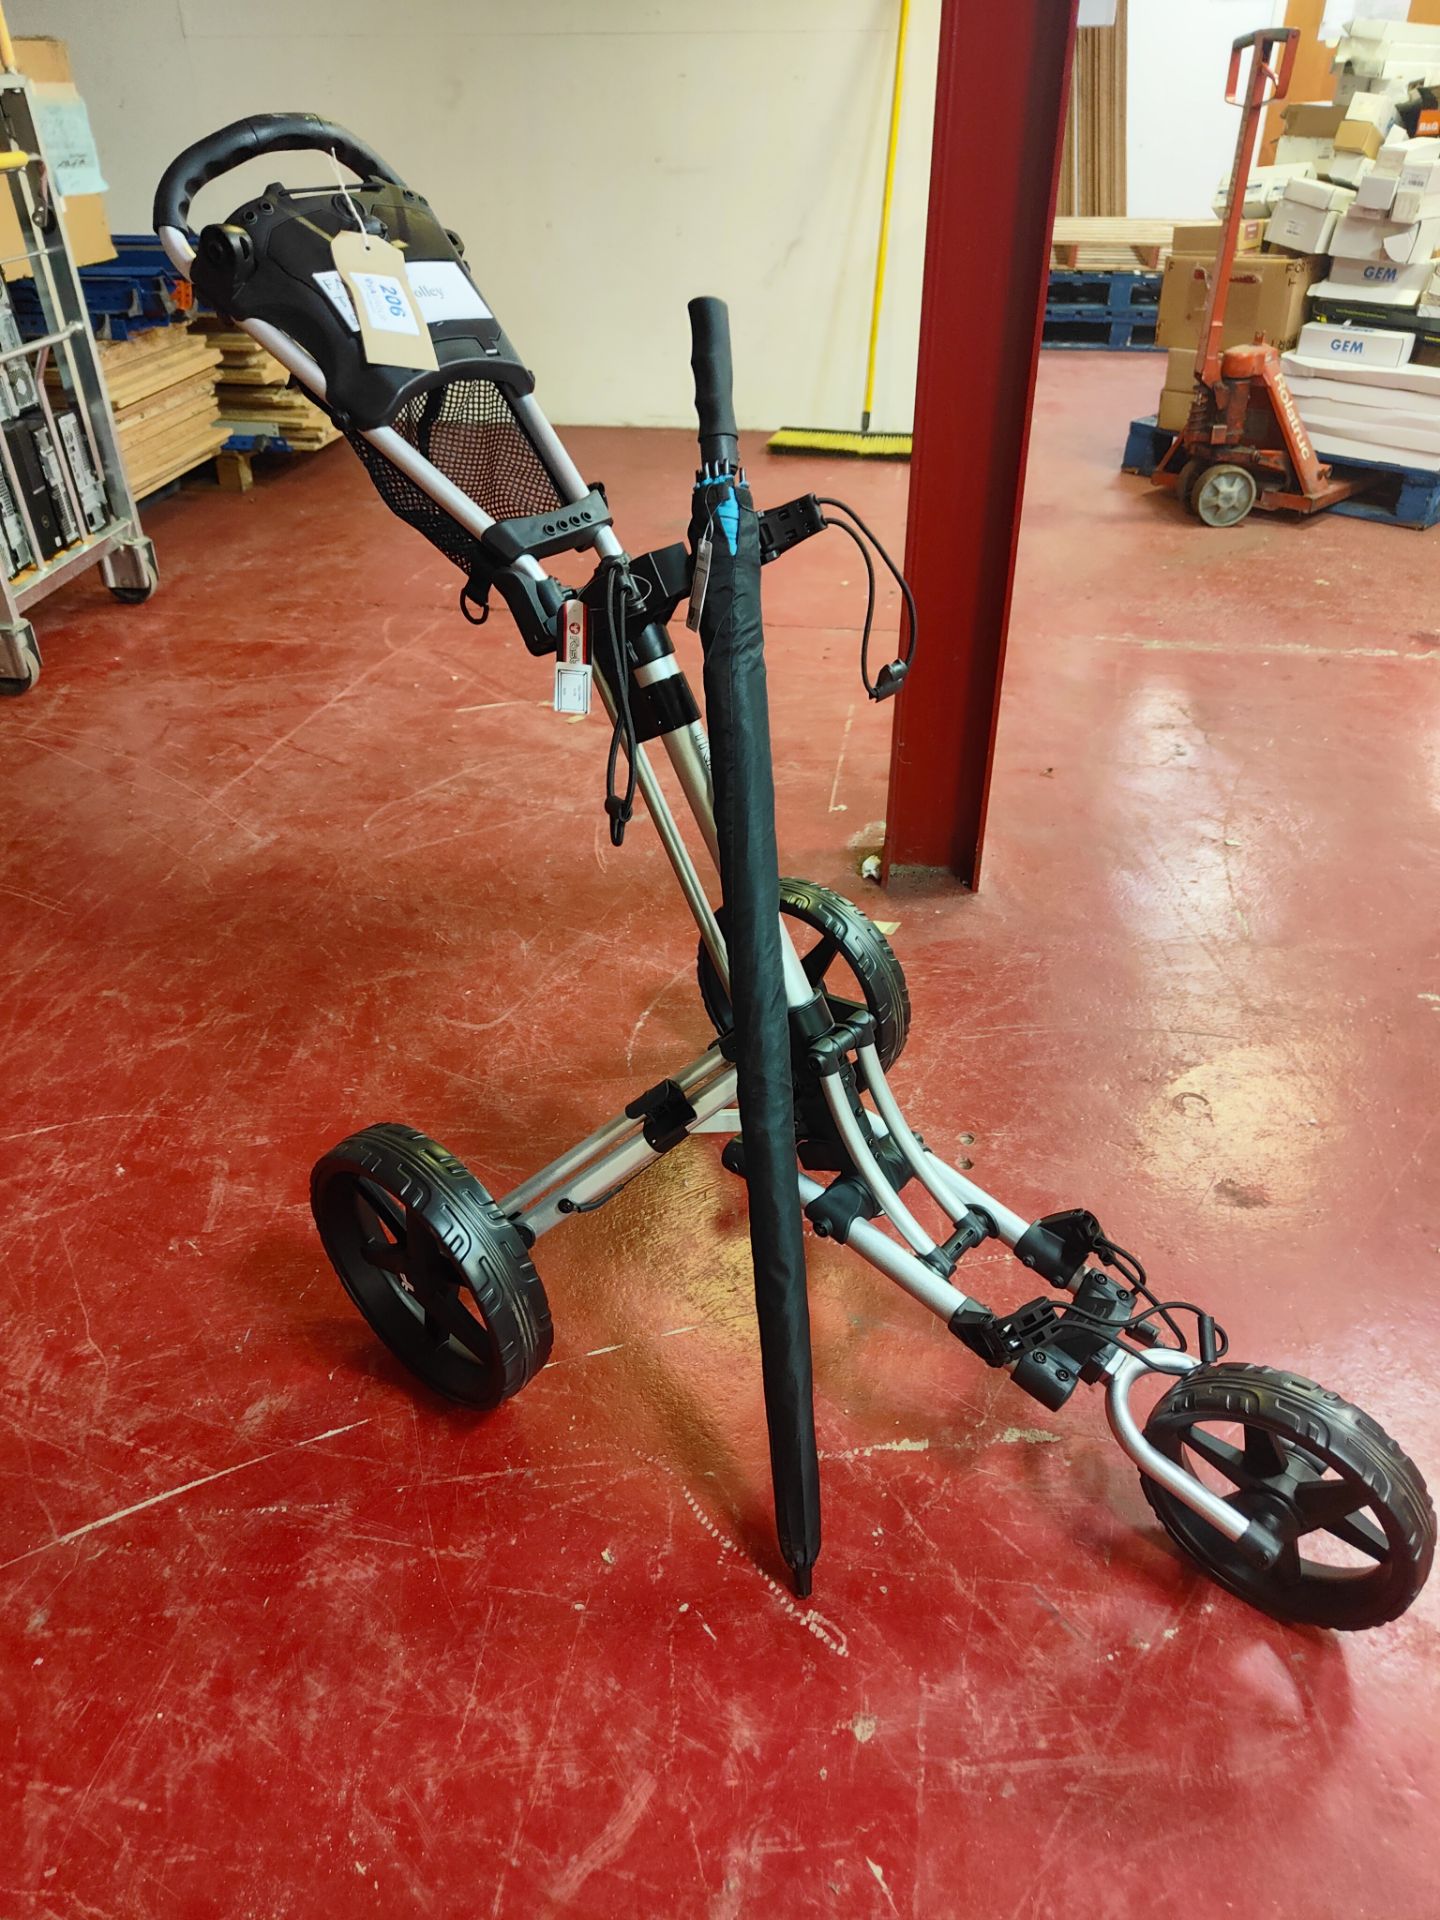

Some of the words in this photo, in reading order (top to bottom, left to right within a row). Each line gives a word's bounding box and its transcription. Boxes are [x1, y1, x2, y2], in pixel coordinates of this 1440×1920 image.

[1364, 266, 1398, 281] GEM
[379, 283, 406, 318] 206
[1330, 339, 1363, 353] GEM
[1274, 373, 1311, 460] Rolatruc
